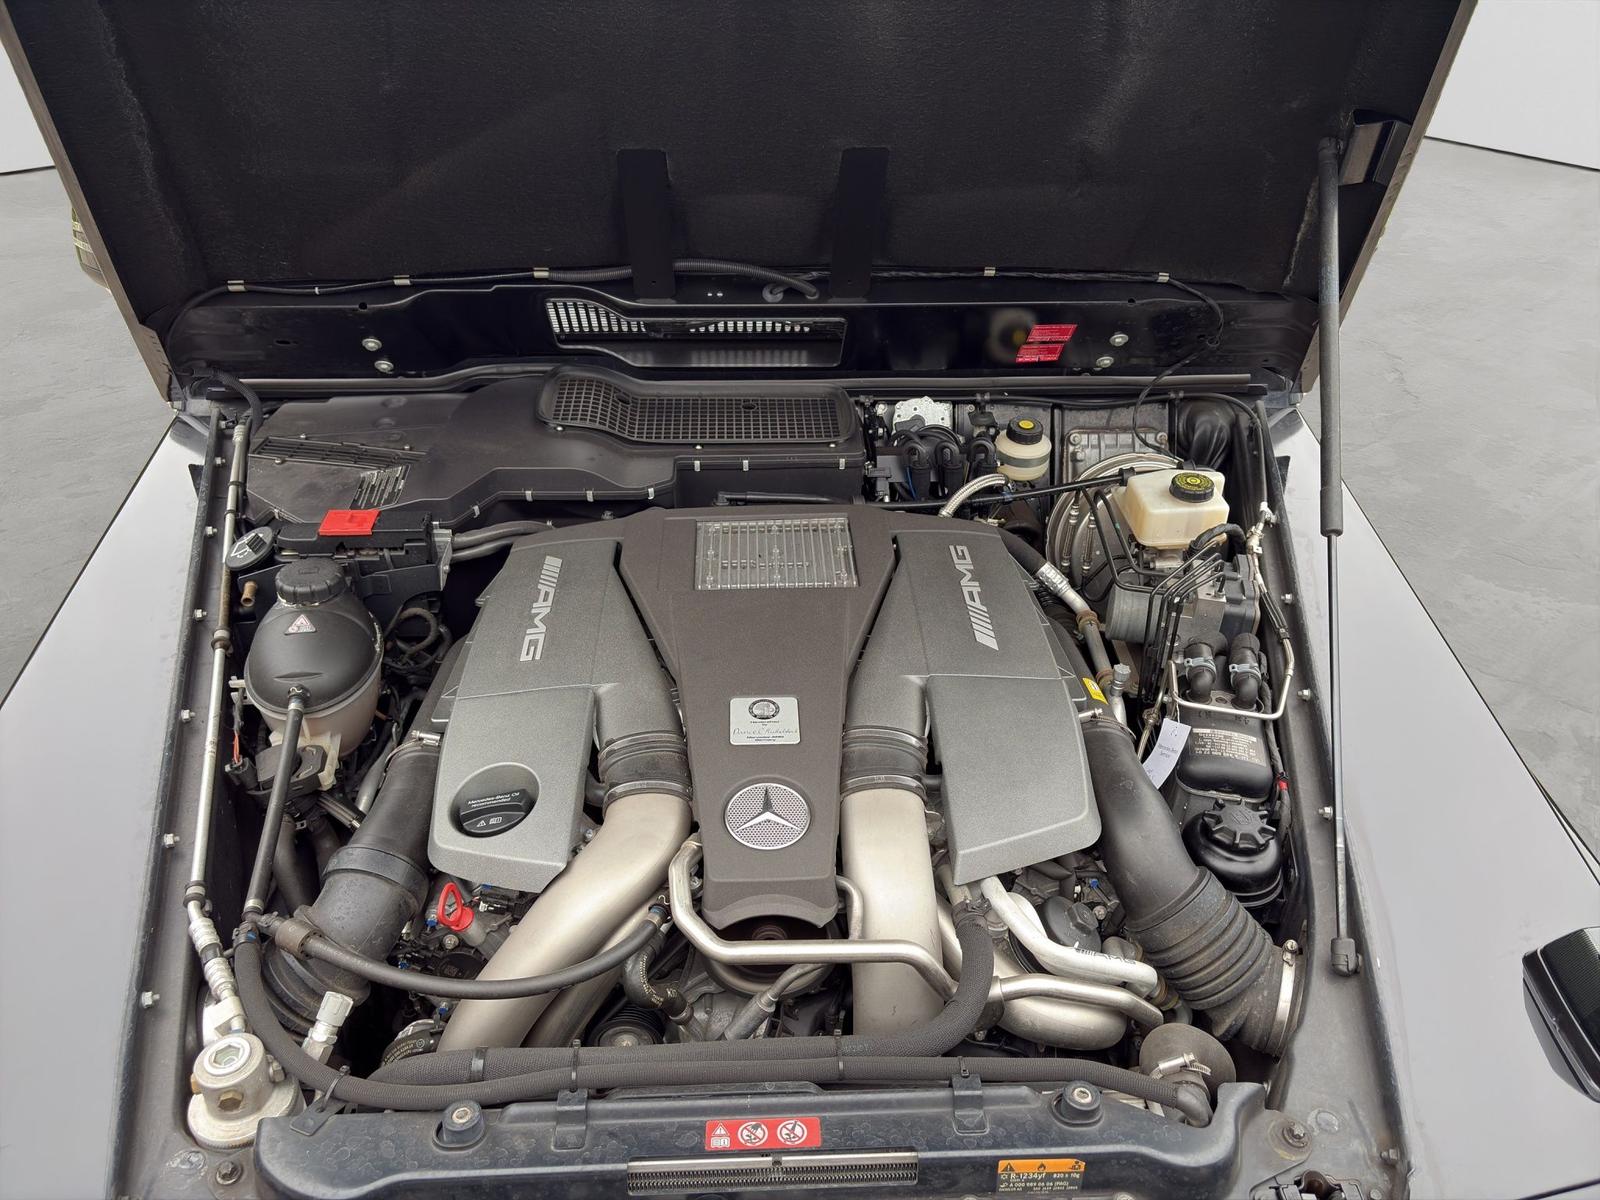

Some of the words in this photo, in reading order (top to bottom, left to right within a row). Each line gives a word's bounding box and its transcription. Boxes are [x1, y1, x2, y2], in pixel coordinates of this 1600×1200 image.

[949, 545, 988, 614] AMG
[519, 582, 556, 662] AMG
[1010, 1172, 1046, 1180] R-1234yf
